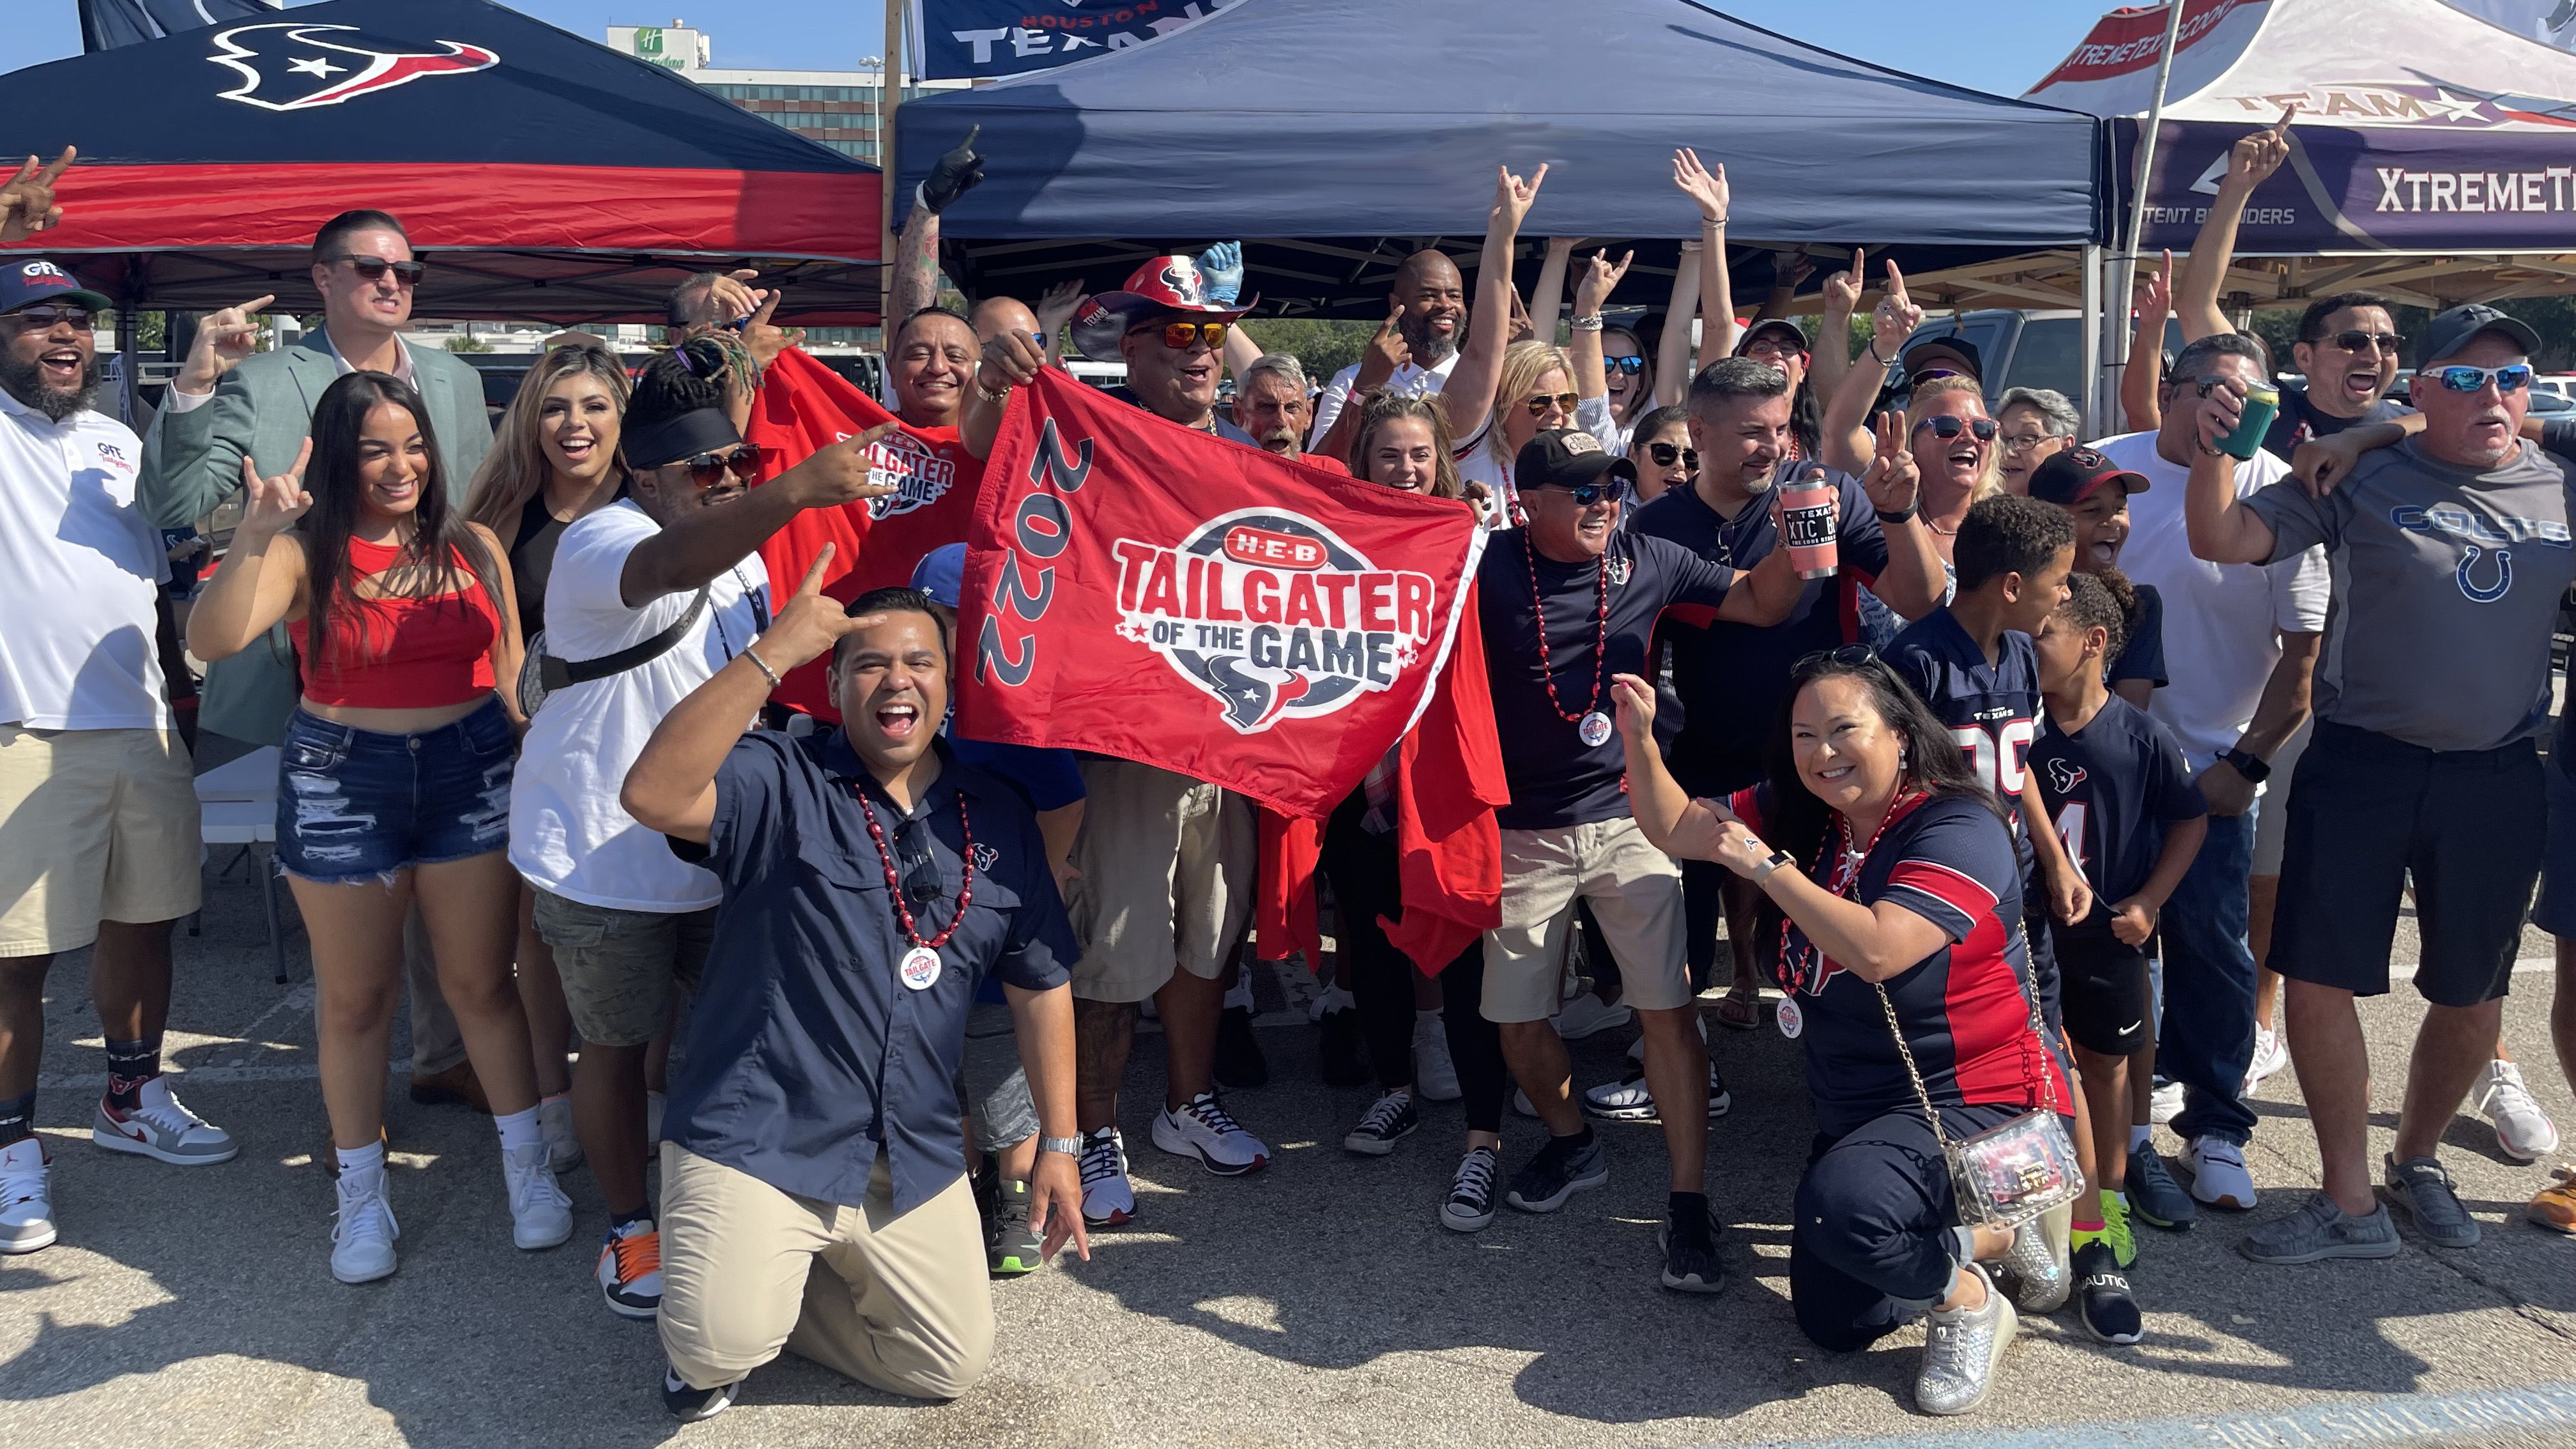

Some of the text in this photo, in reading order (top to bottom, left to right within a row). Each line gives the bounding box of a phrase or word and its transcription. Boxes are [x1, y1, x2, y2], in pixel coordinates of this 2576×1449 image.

[952, 1, 1223, 63] TEXAN
[1022, 1, 1159, 30] HOUSTON
[2216, 92, 2430, 119] TEAM
[2375, 165, 2576, 213] XTREMET
[2143, 207, 2190, 224] TENT
[2390, 504, 2573, 551] COLTS
[974, 416, 1094, 687] 2022
[1117, 542, 1432, 640] TAILGATER
[1152, 620, 1395, 686] OF THE GAME
[904, 958, 937, 977] TAILGATE
